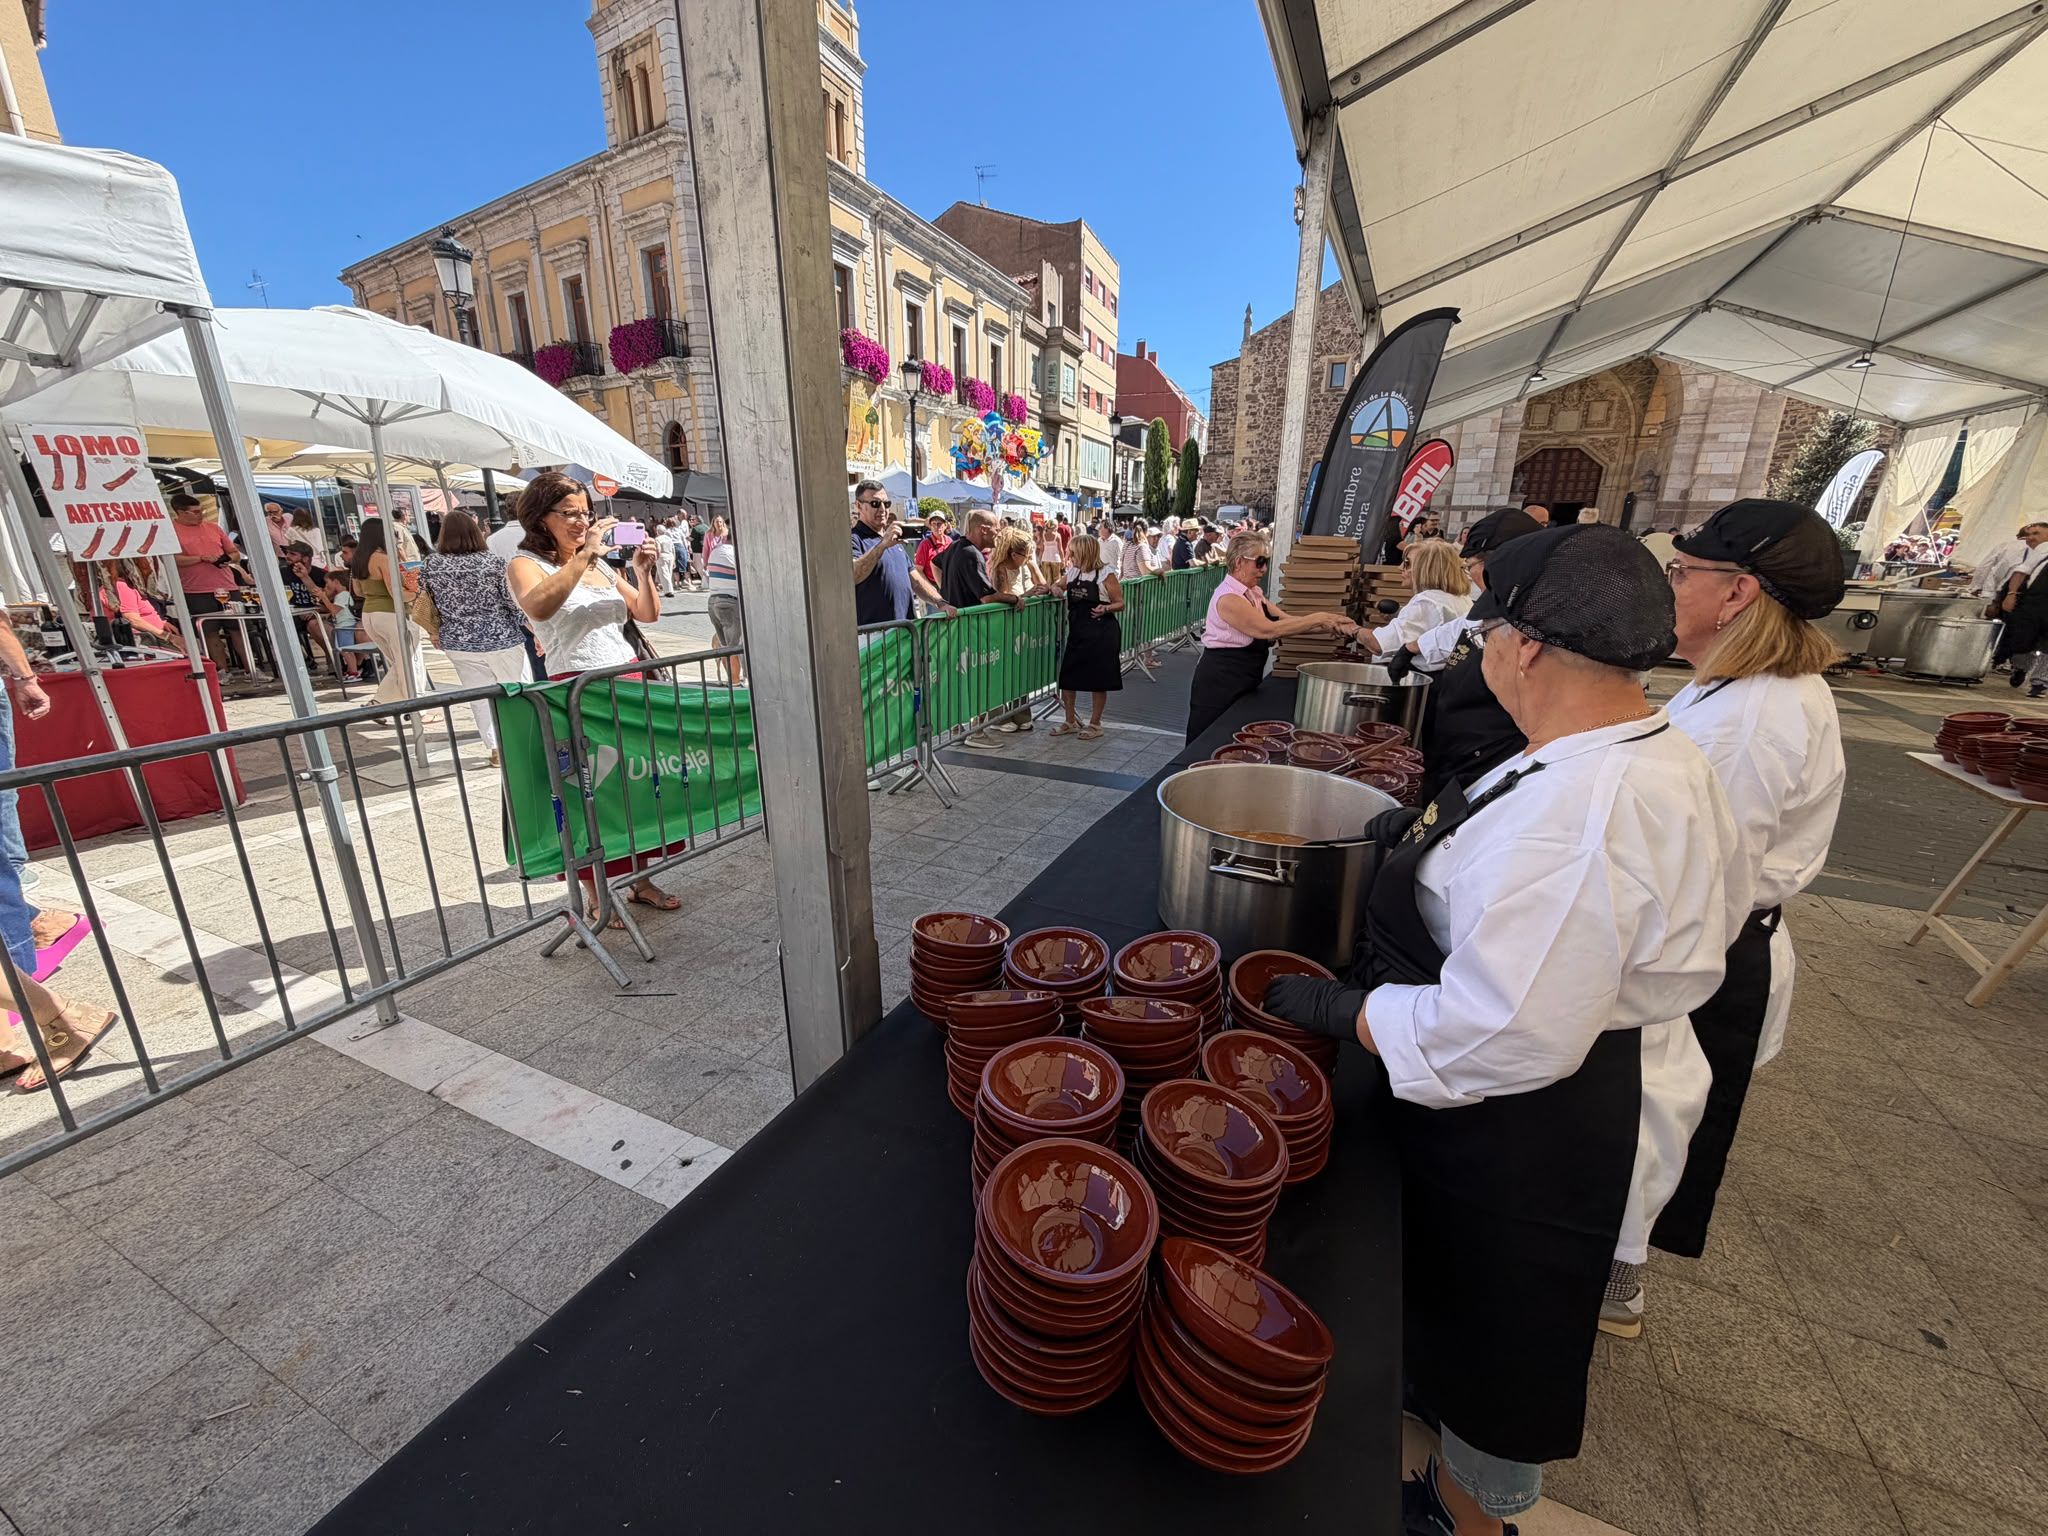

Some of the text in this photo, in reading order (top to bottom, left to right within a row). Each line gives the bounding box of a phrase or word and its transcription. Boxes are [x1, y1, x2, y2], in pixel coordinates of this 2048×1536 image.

[32, 434, 141, 456] LOMO
[64, 501, 165, 524] ARTESANAL
[1333, 467, 1362, 537] legumbre
[1393, 462, 1451, 527] BRIL
